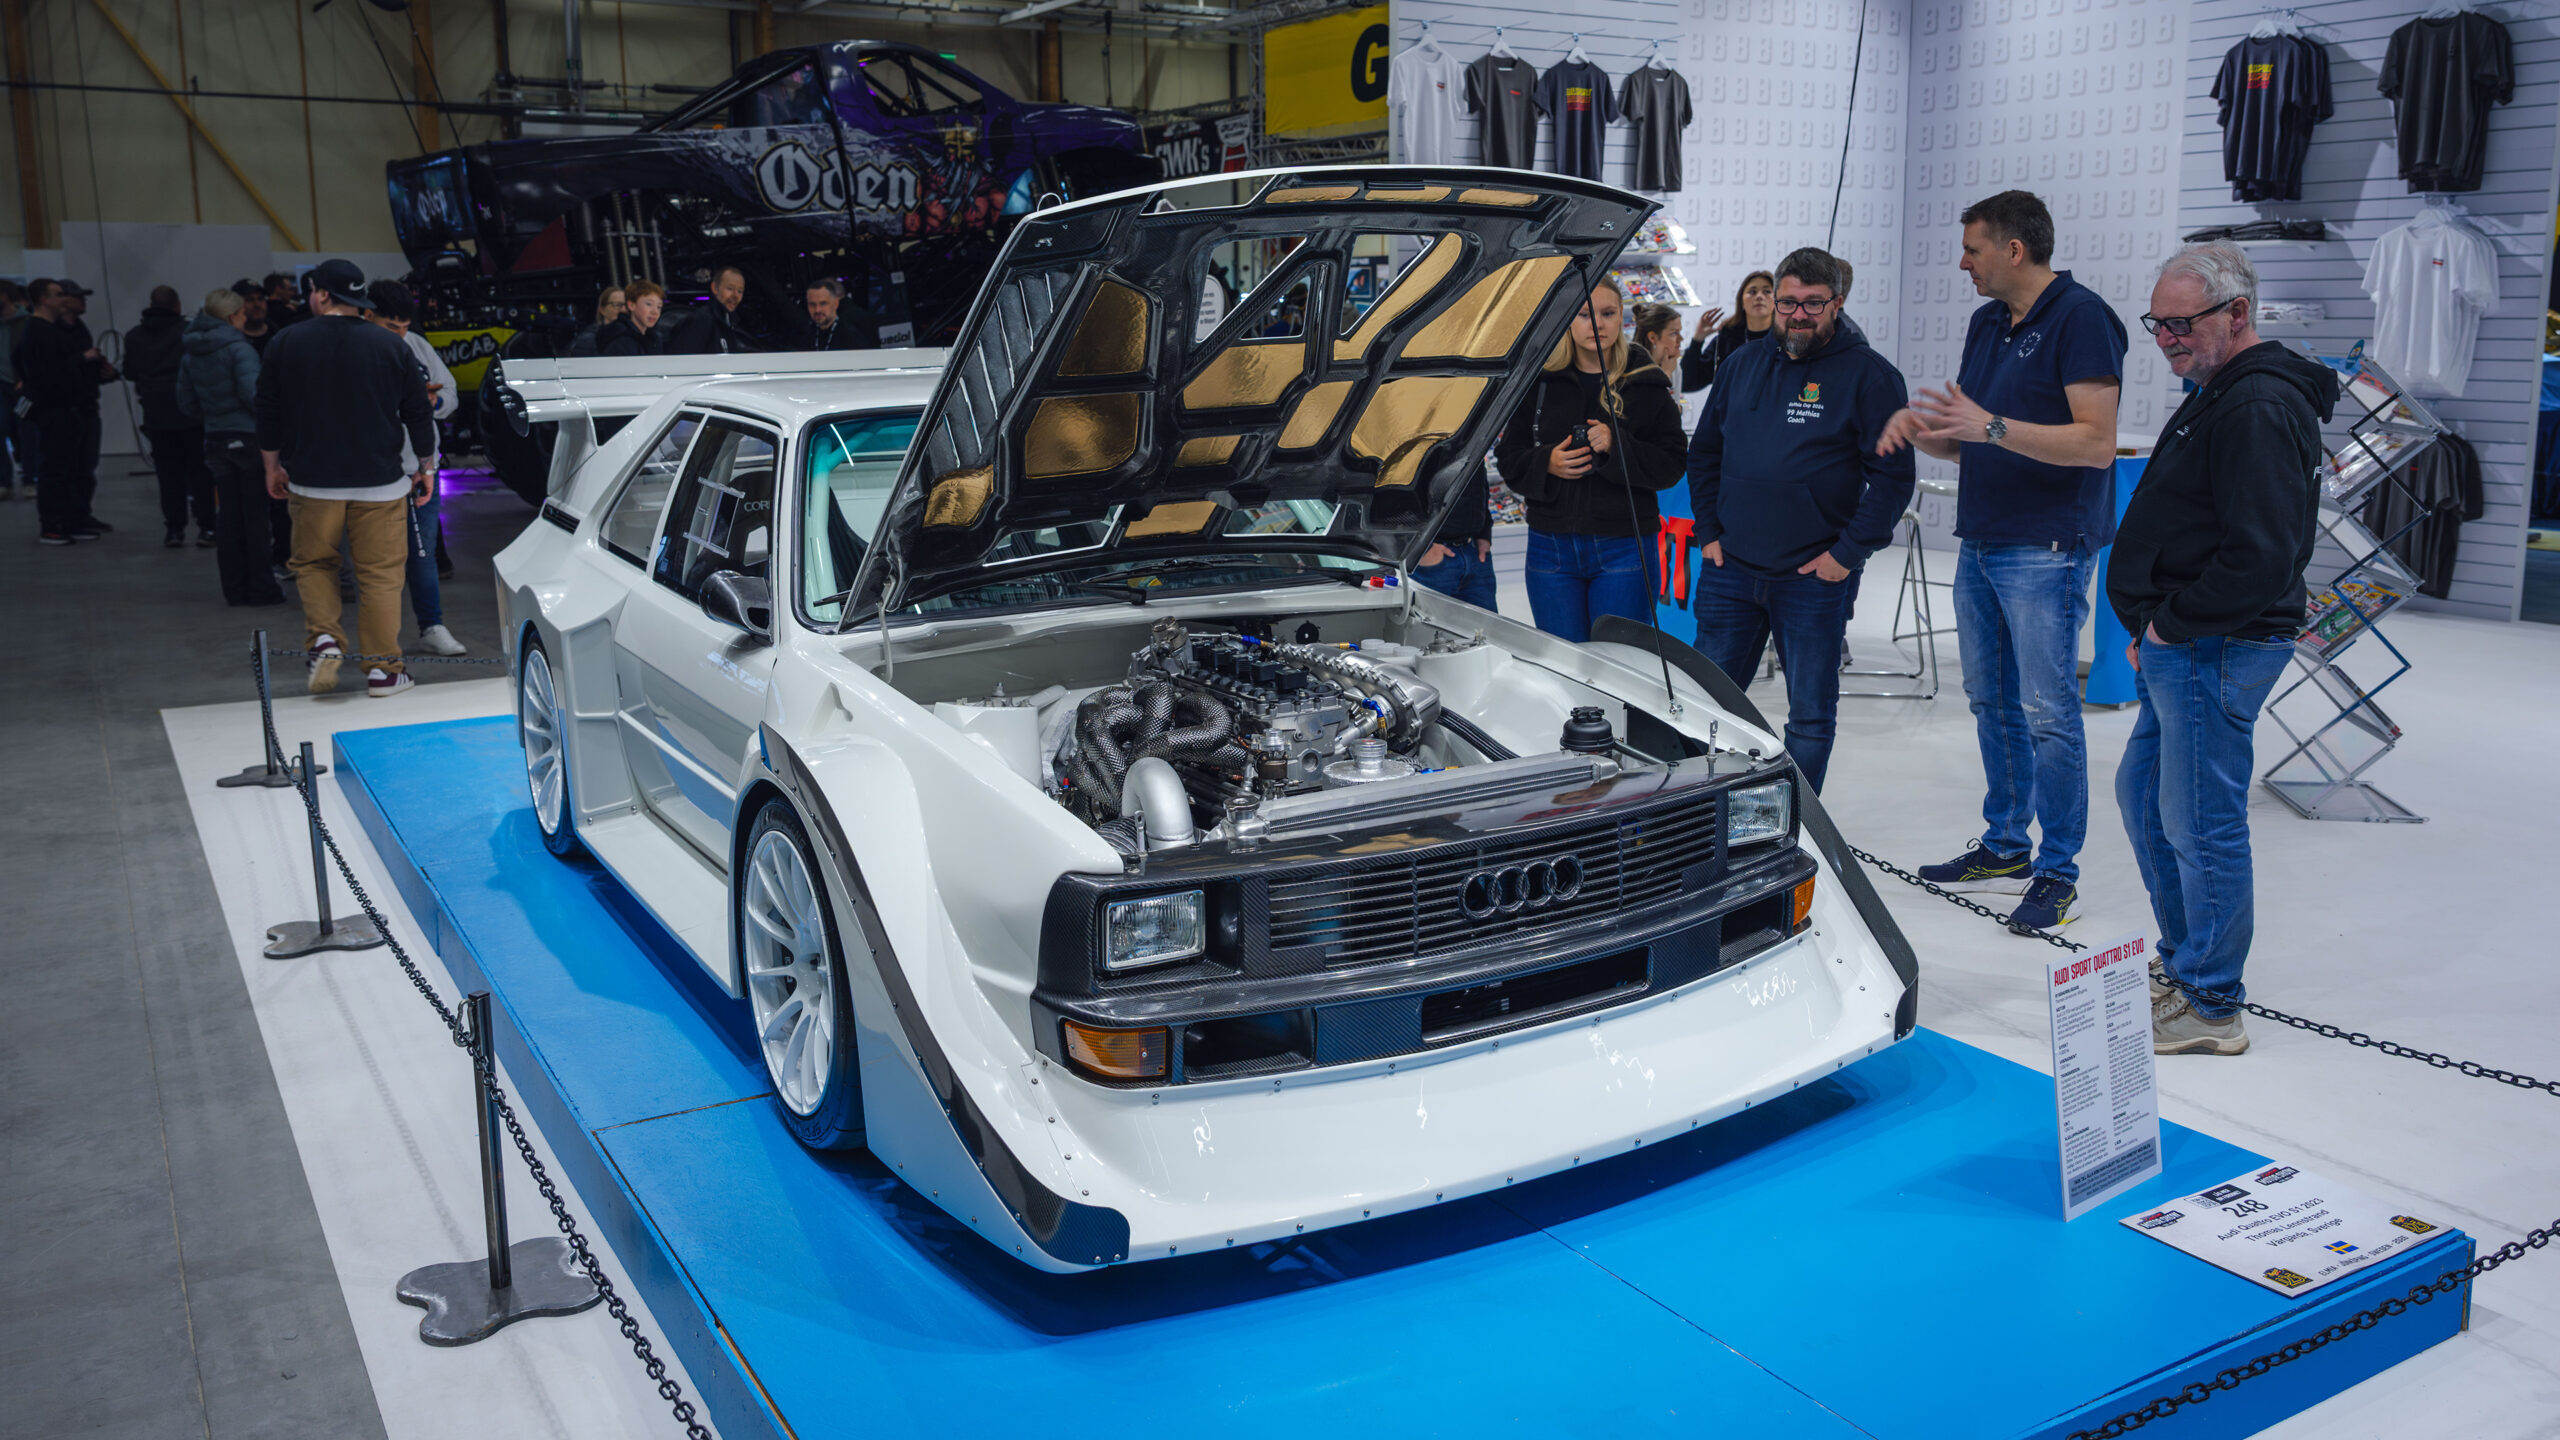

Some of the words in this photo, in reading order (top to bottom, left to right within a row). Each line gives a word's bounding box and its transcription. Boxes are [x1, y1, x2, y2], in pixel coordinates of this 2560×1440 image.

[757, 141, 920, 212] Oden
[1787, 416, 1805, 424] Coach
[1796, 409, 1820, 418] Mathias
[743, 500, 771, 513] COR
[2054, 966, 2070, 987] AUDI
[2070, 957, 2092, 980] SPORT
[2093, 946, 2122, 973] QUATTRO
[2123, 942, 2131, 959] S1
[2132, 937, 2144, 956] EVO
[2222, 1199, 2269, 1218] 248
[2217, 1227, 2240, 1241] Audi
[2238, 1217, 2271, 1231] Quattro
[2269, 1210, 2291, 1222] EVO
[2288, 1205, 2302, 1214] S1
[2245, 1226, 2284, 1242] Thomas
[2280, 1209, 2330, 1232] Lennstrand
[2307, 1217, 2343, 1234] Sverige
[2317, 1264, 2338, 1276] ELMIA
[2367, 1243, 2393, 1256] SWEDEN
